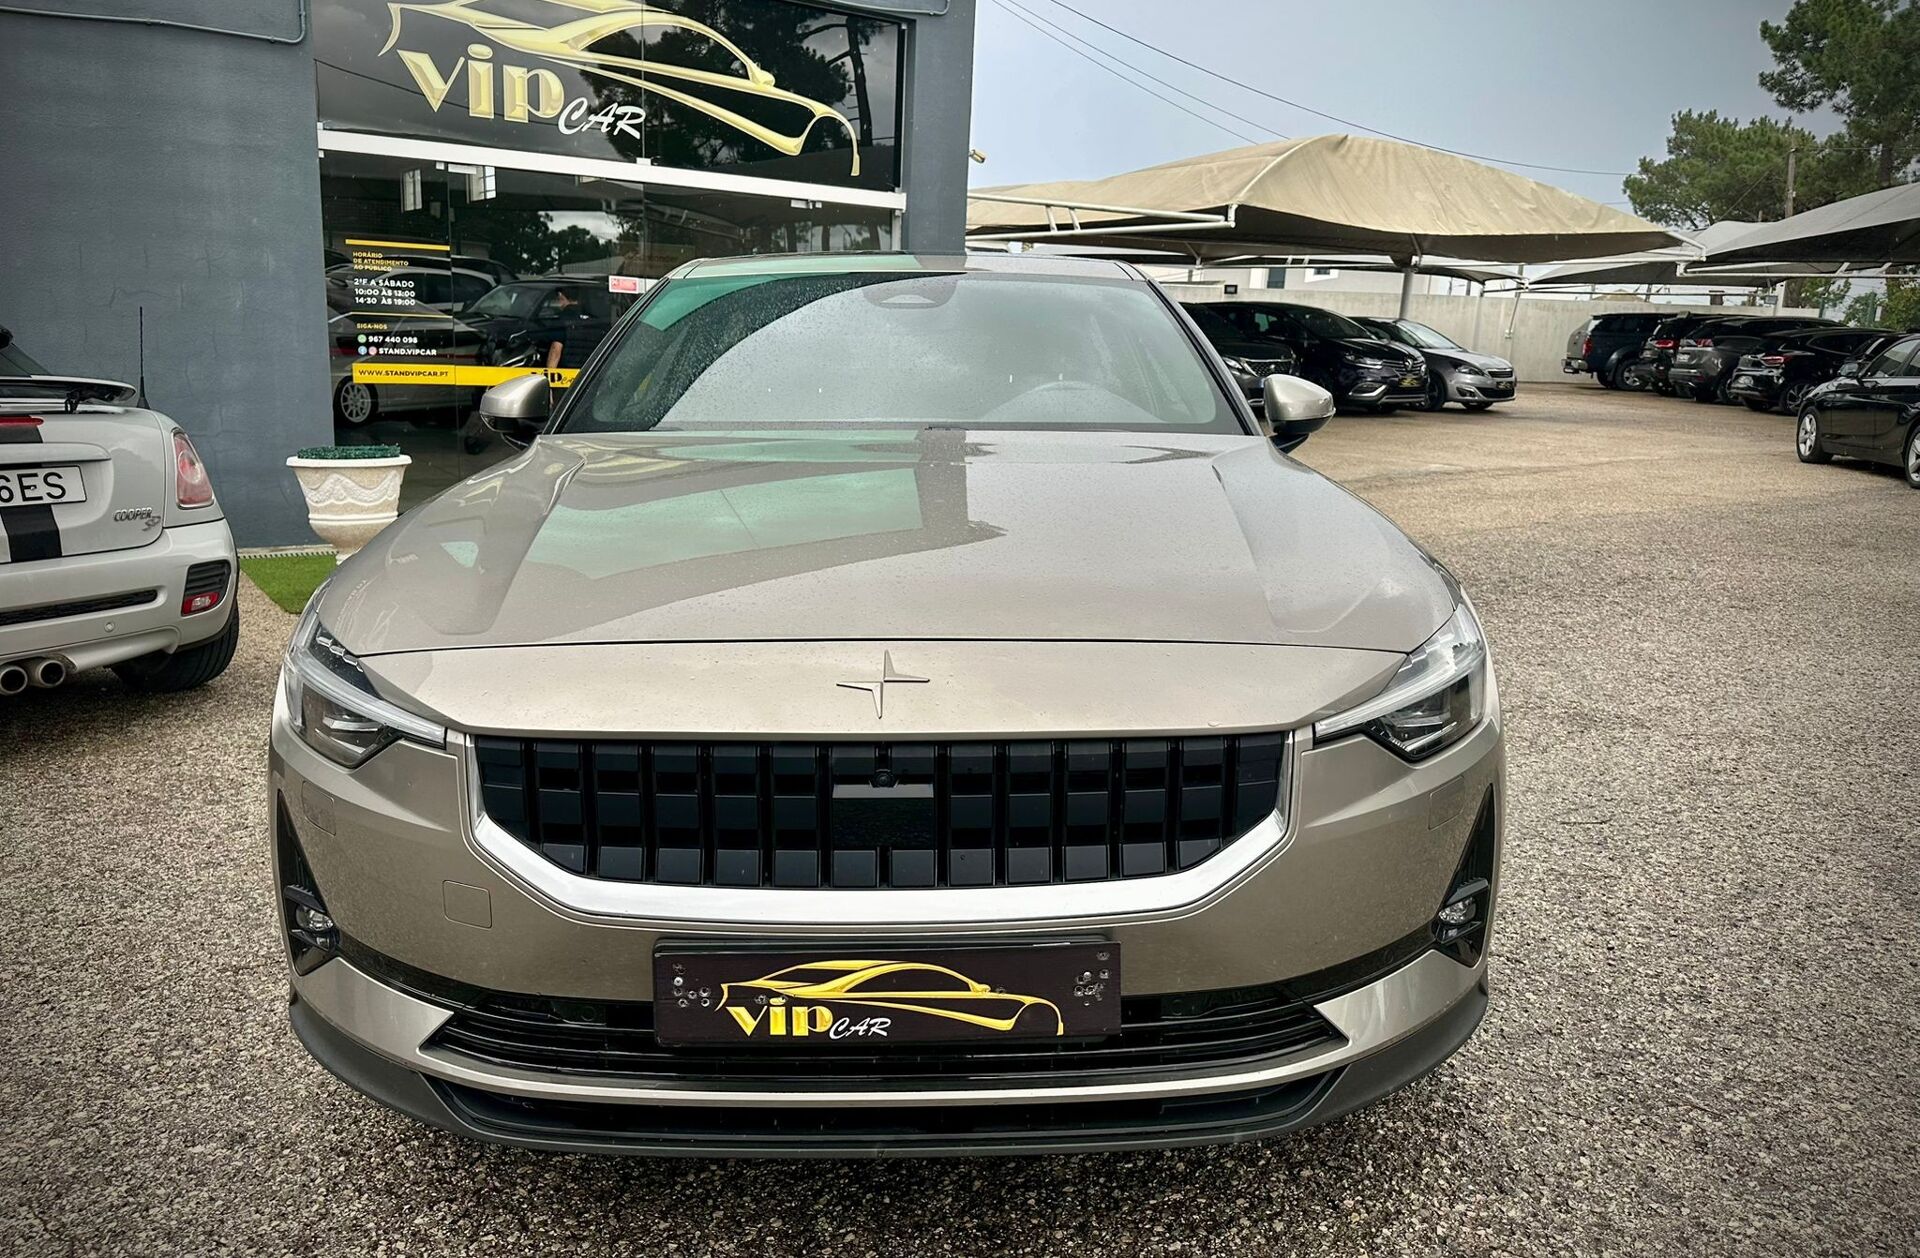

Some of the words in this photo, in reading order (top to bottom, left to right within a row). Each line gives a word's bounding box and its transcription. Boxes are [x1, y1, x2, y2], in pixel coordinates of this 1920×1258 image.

[558, 97, 646, 139] CAR
[379, 277, 415, 288] SÁBADO
[355, 288, 379, 296] 10:00
[368, 335, 383, 343] 967
[385, 336, 401, 344] 440
[402, 336, 418, 344] 098
[379, 347, 437, 356] STAND.VIPCAR
[358, 369, 449, 377] WWW.STANDVIPCAR.PT
[113, 506, 153, 522] COOPER
[828, 1017, 892, 1040] CAR
